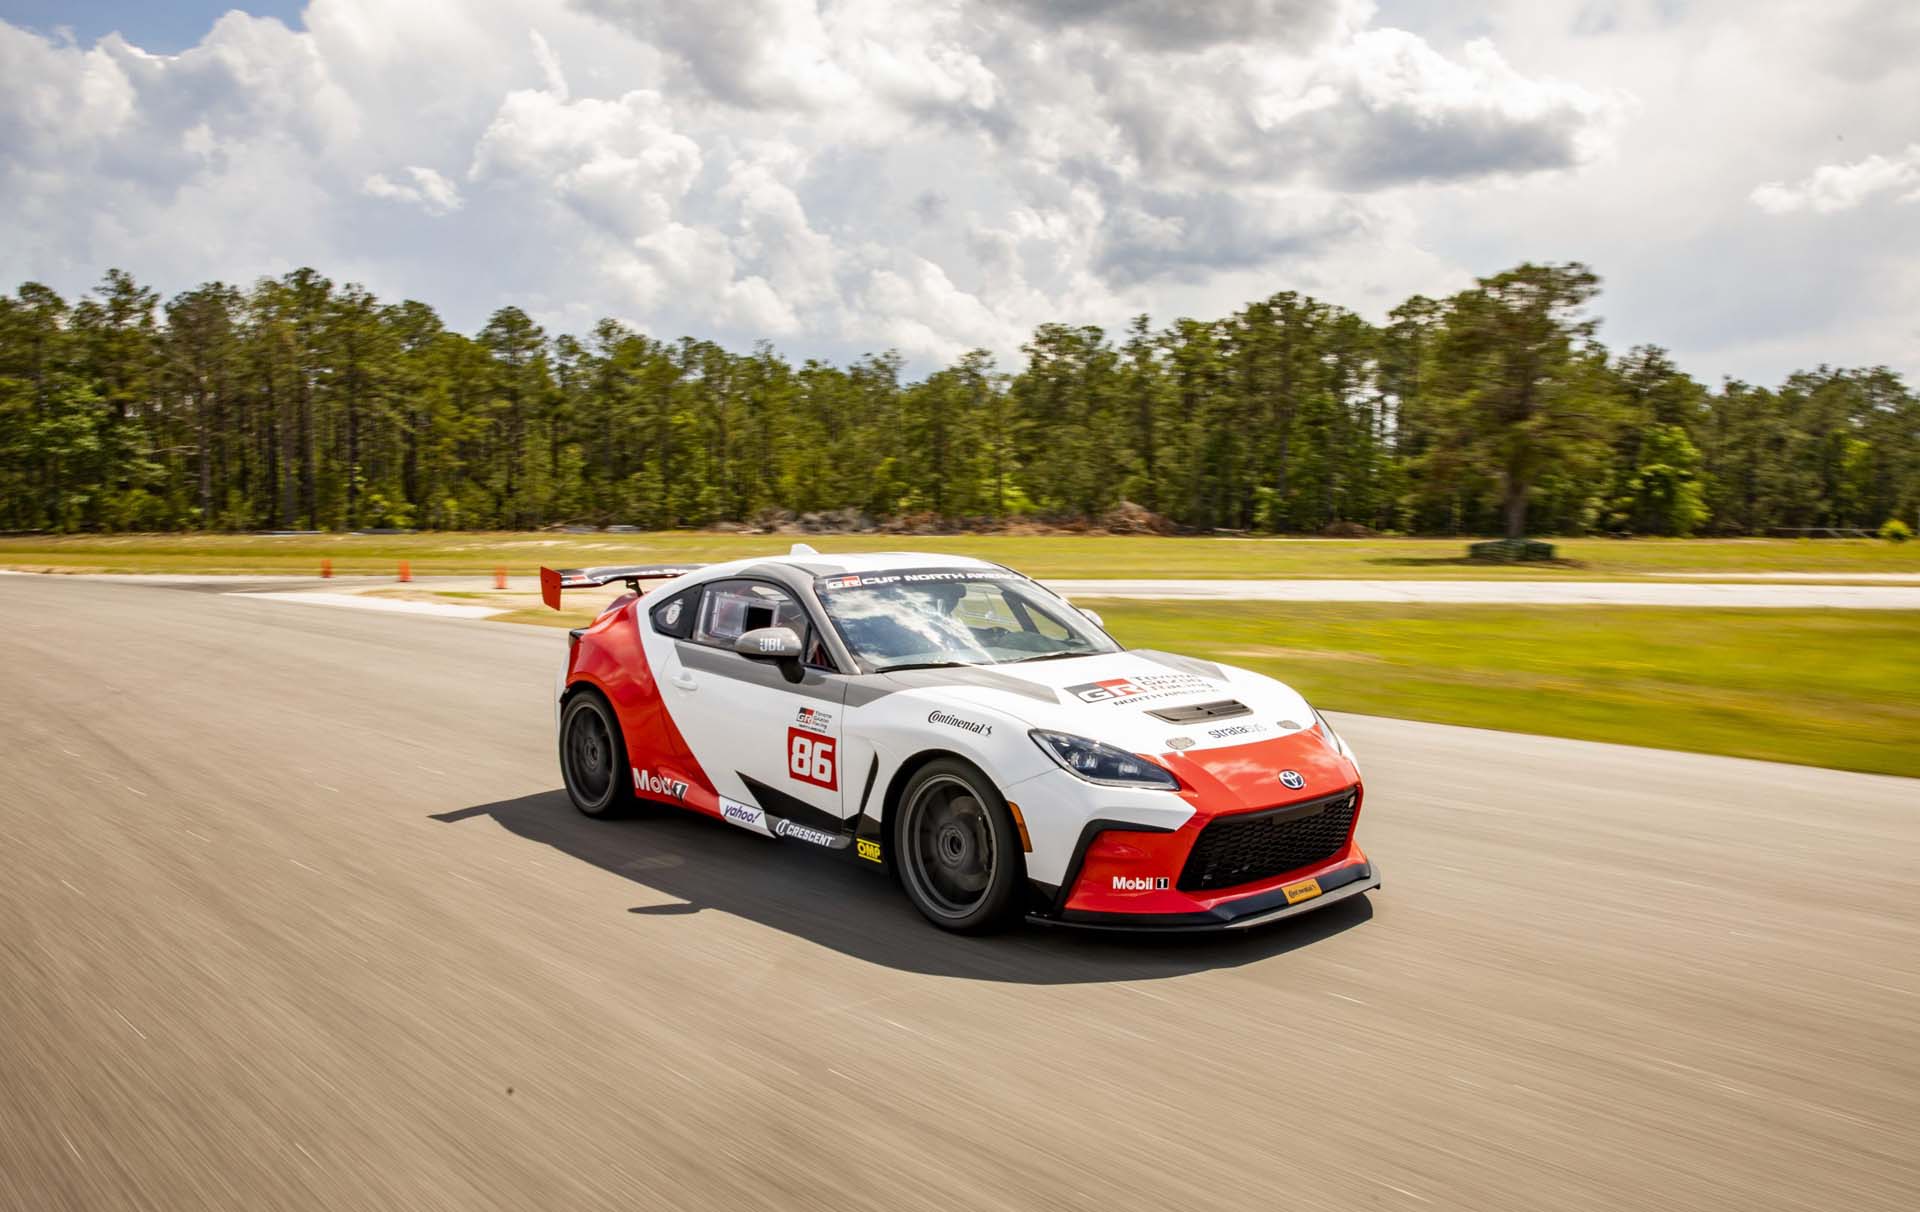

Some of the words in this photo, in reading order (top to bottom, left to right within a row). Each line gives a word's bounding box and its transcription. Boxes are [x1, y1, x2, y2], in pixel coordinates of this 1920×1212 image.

[827, 576, 861, 589] GR
[862, 576, 901, 585] CUP
[905, 573, 964, 582] NORTH
[759, 638, 785, 651] JBL
[1078, 682, 1146, 701] GR
[928, 710, 985, 734] Continental
[791, 735, 833, 783] 86
[724, 804, 762, 823] yahoo!
[786, 825, 832, 847] CRESCENT
[857, 842, 881, 858] OMP
[1112, 876, 1153, 890] Mobil
